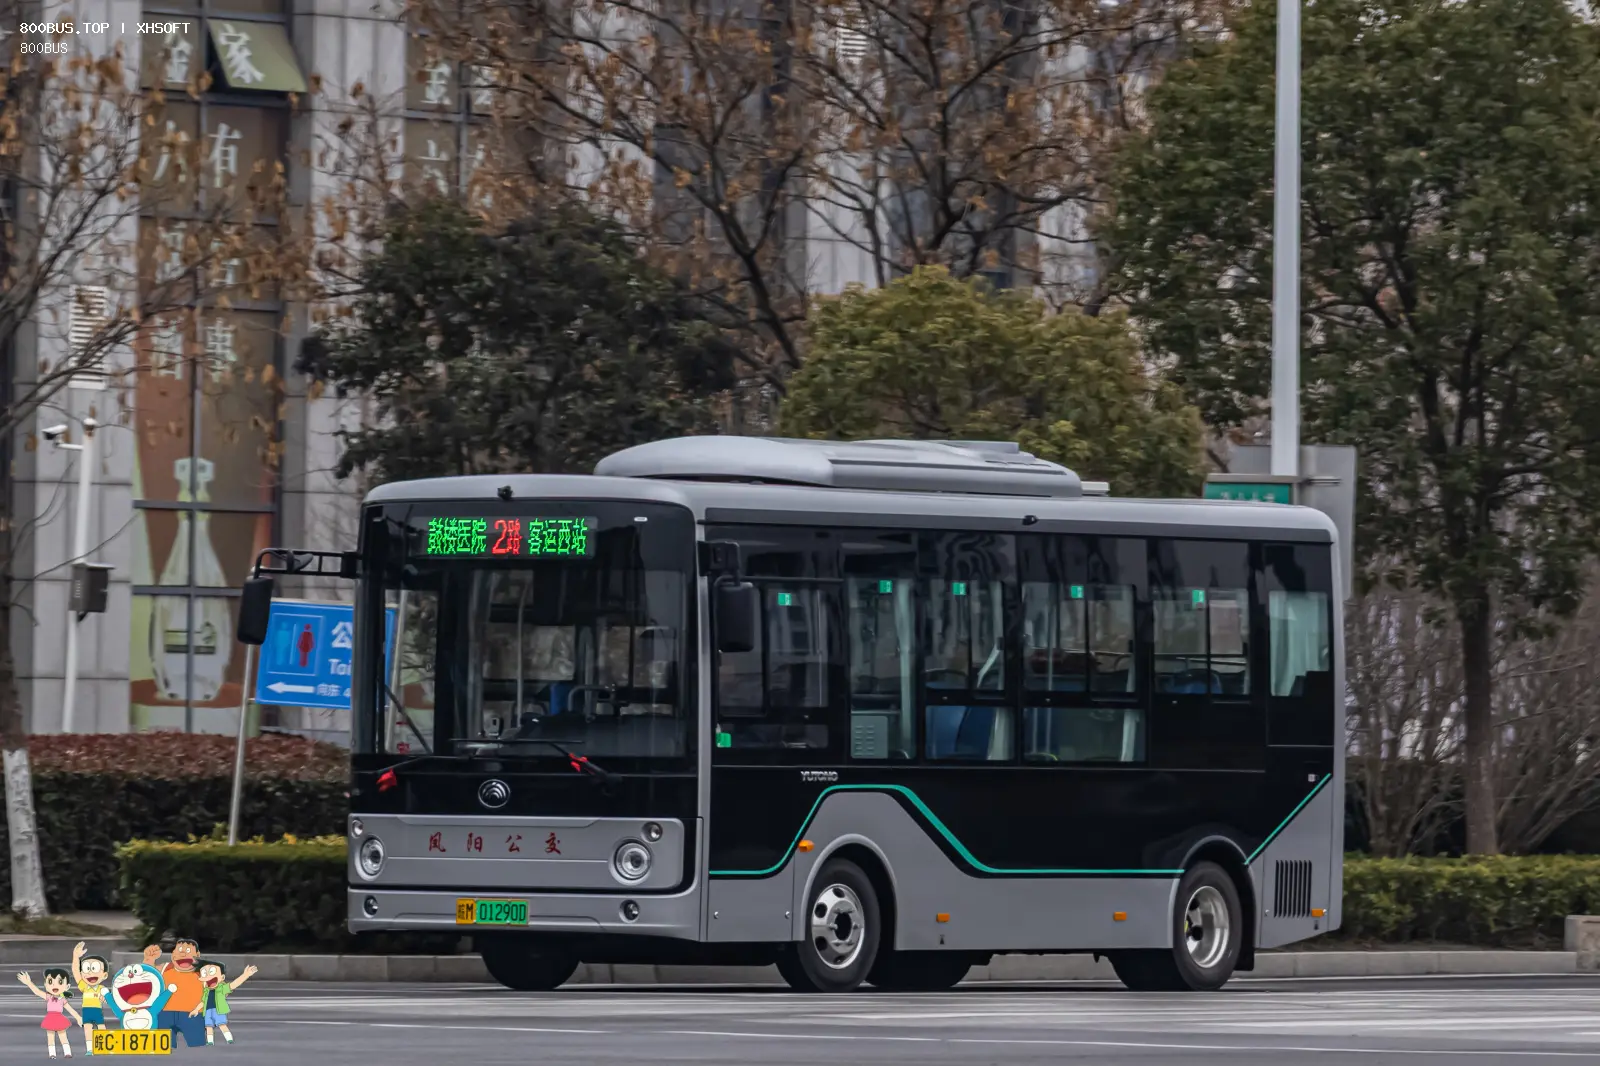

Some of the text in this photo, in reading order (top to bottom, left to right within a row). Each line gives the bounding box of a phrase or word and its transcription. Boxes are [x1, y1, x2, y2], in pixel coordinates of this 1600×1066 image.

[492, 517, 522, 555] 2路
[528, 517, 588, 555] 客运西站
[428, 831, 562, 855] 凤阳公交
